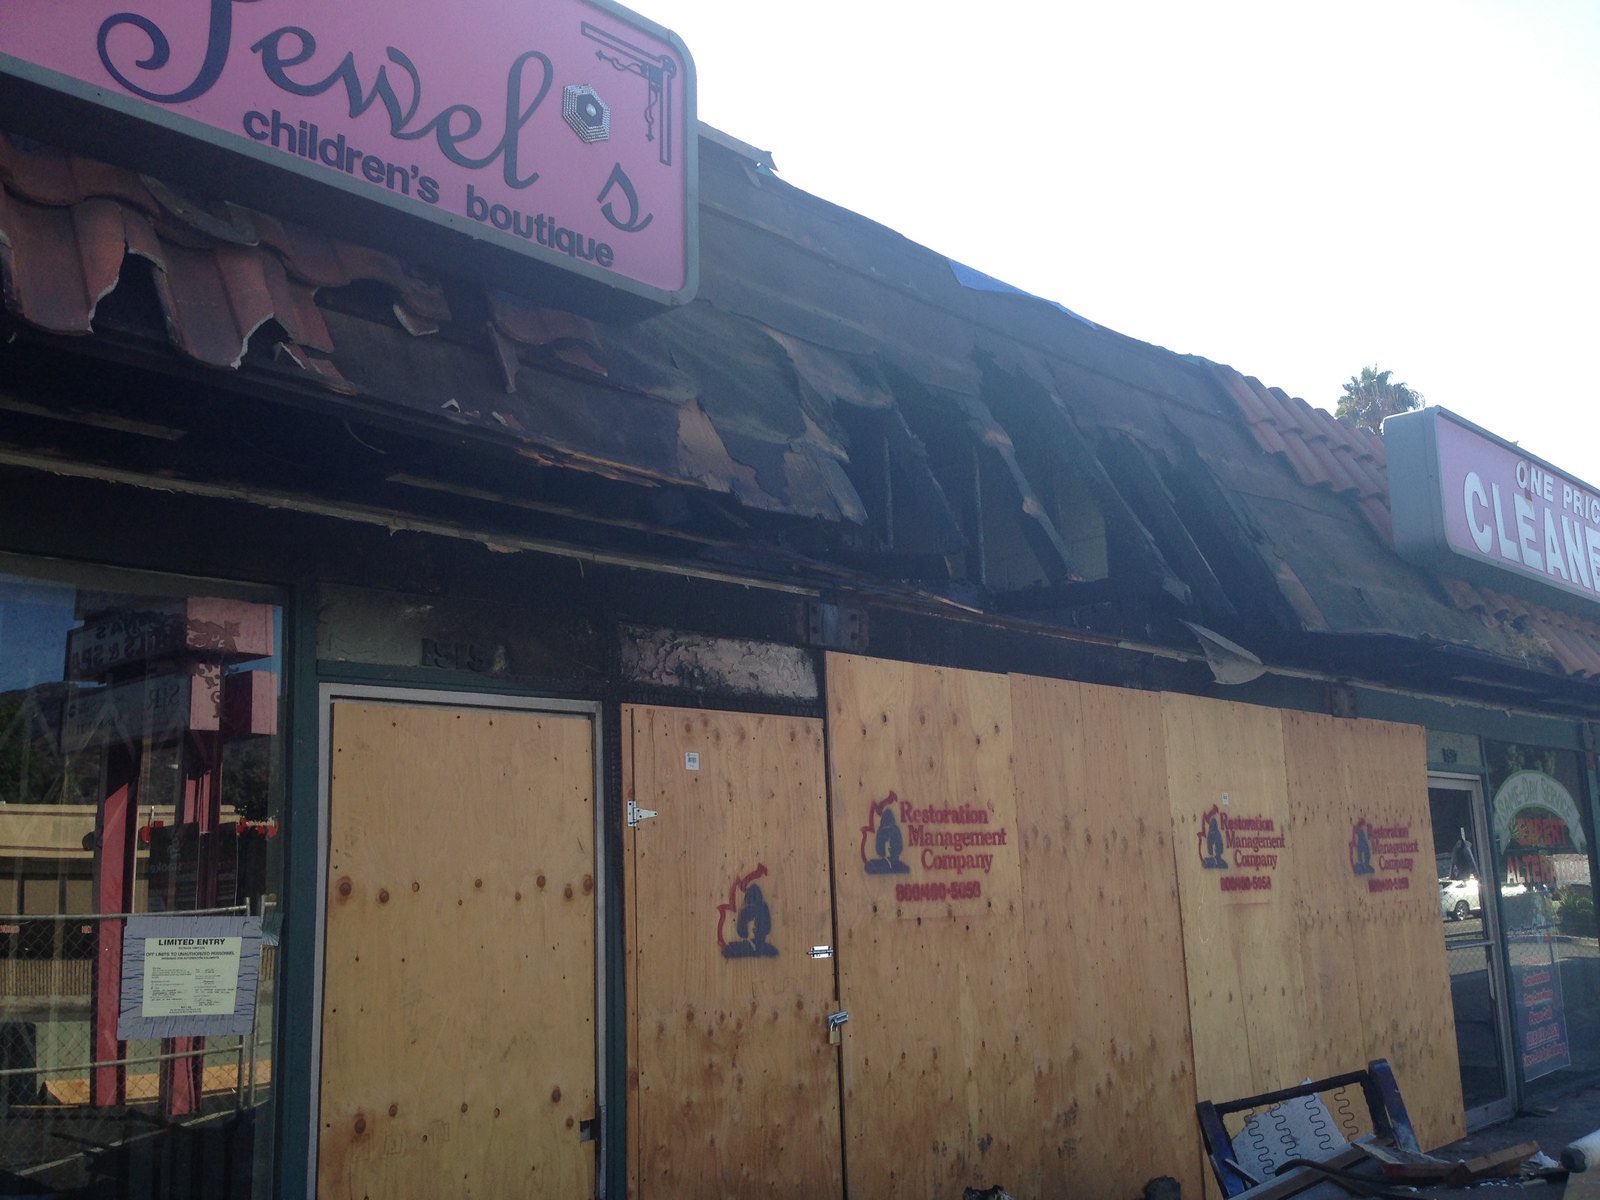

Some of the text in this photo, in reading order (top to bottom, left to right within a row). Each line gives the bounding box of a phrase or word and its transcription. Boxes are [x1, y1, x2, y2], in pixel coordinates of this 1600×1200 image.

[242, 109, 614, 267] children's boutique
[1515, 460, 1554, 503] ONE
[900, 800, 988, 824] Restoration
[1220, 813, 1274, 831] Restoration
[908, 825, 1007, 851] Management
[1226, 831, 1285, 852] Management
[921, 849, 993, 874] Company
[1234, 850, 1278, 870] Company
[1378, 855, 1413, 872] Company
[158, 938, 194, 946] LIMITED
